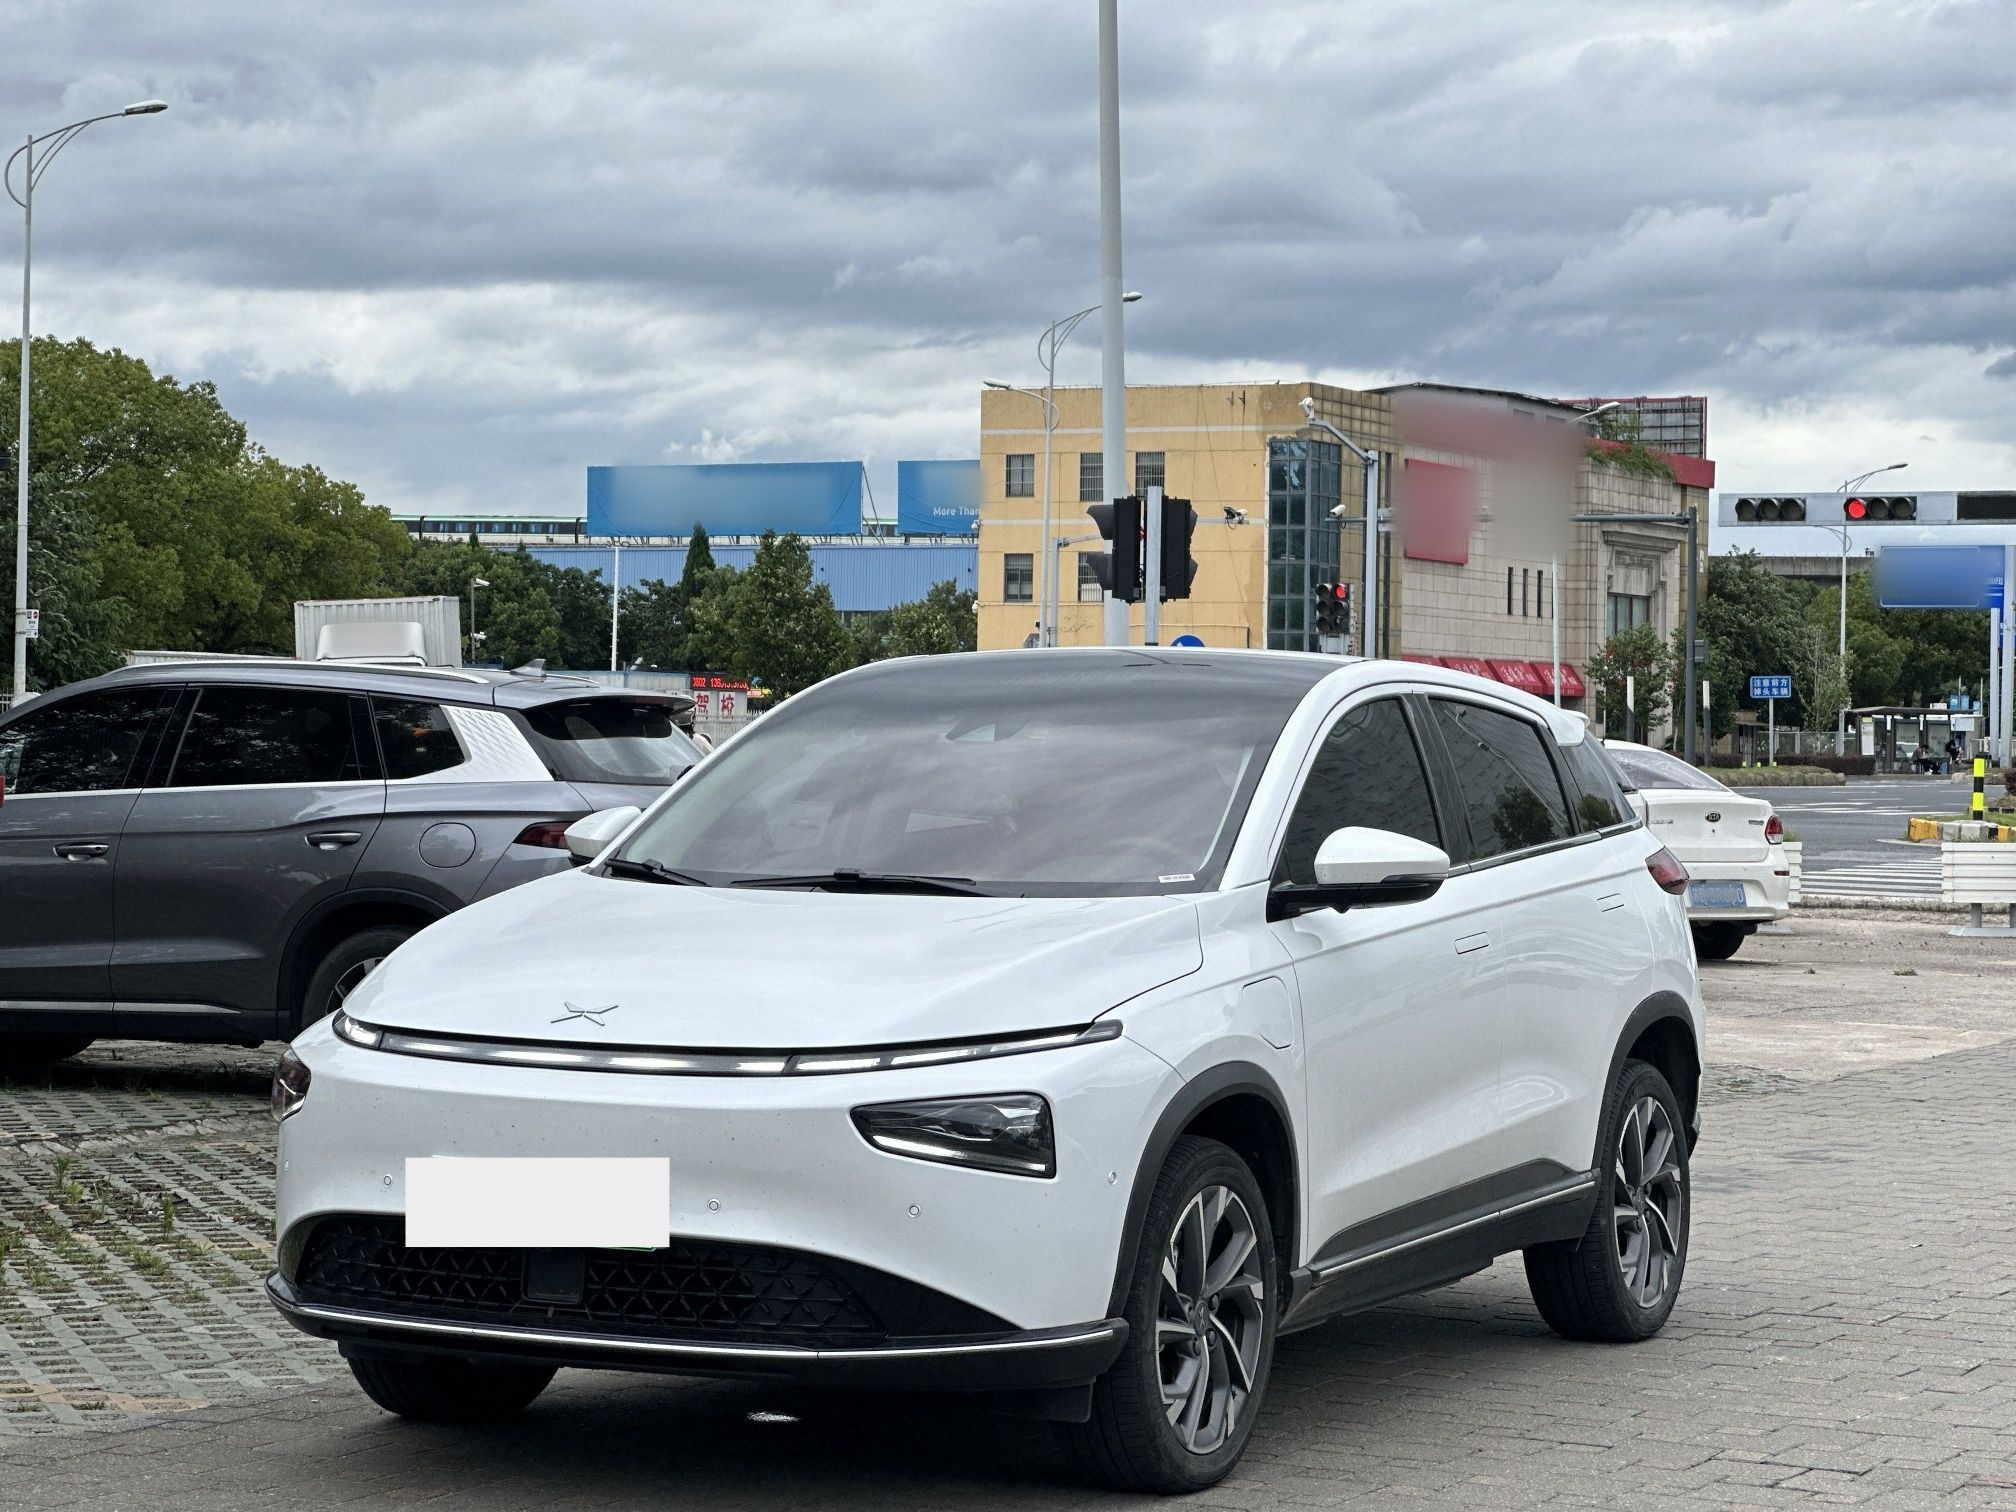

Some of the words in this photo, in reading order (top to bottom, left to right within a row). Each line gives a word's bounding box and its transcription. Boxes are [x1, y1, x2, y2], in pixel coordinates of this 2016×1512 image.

[933, 506, 956, 516] More
[1753, 678, 1788, 687] 注意前方
[1753, 687, 1789, 696] 掉头车辆
